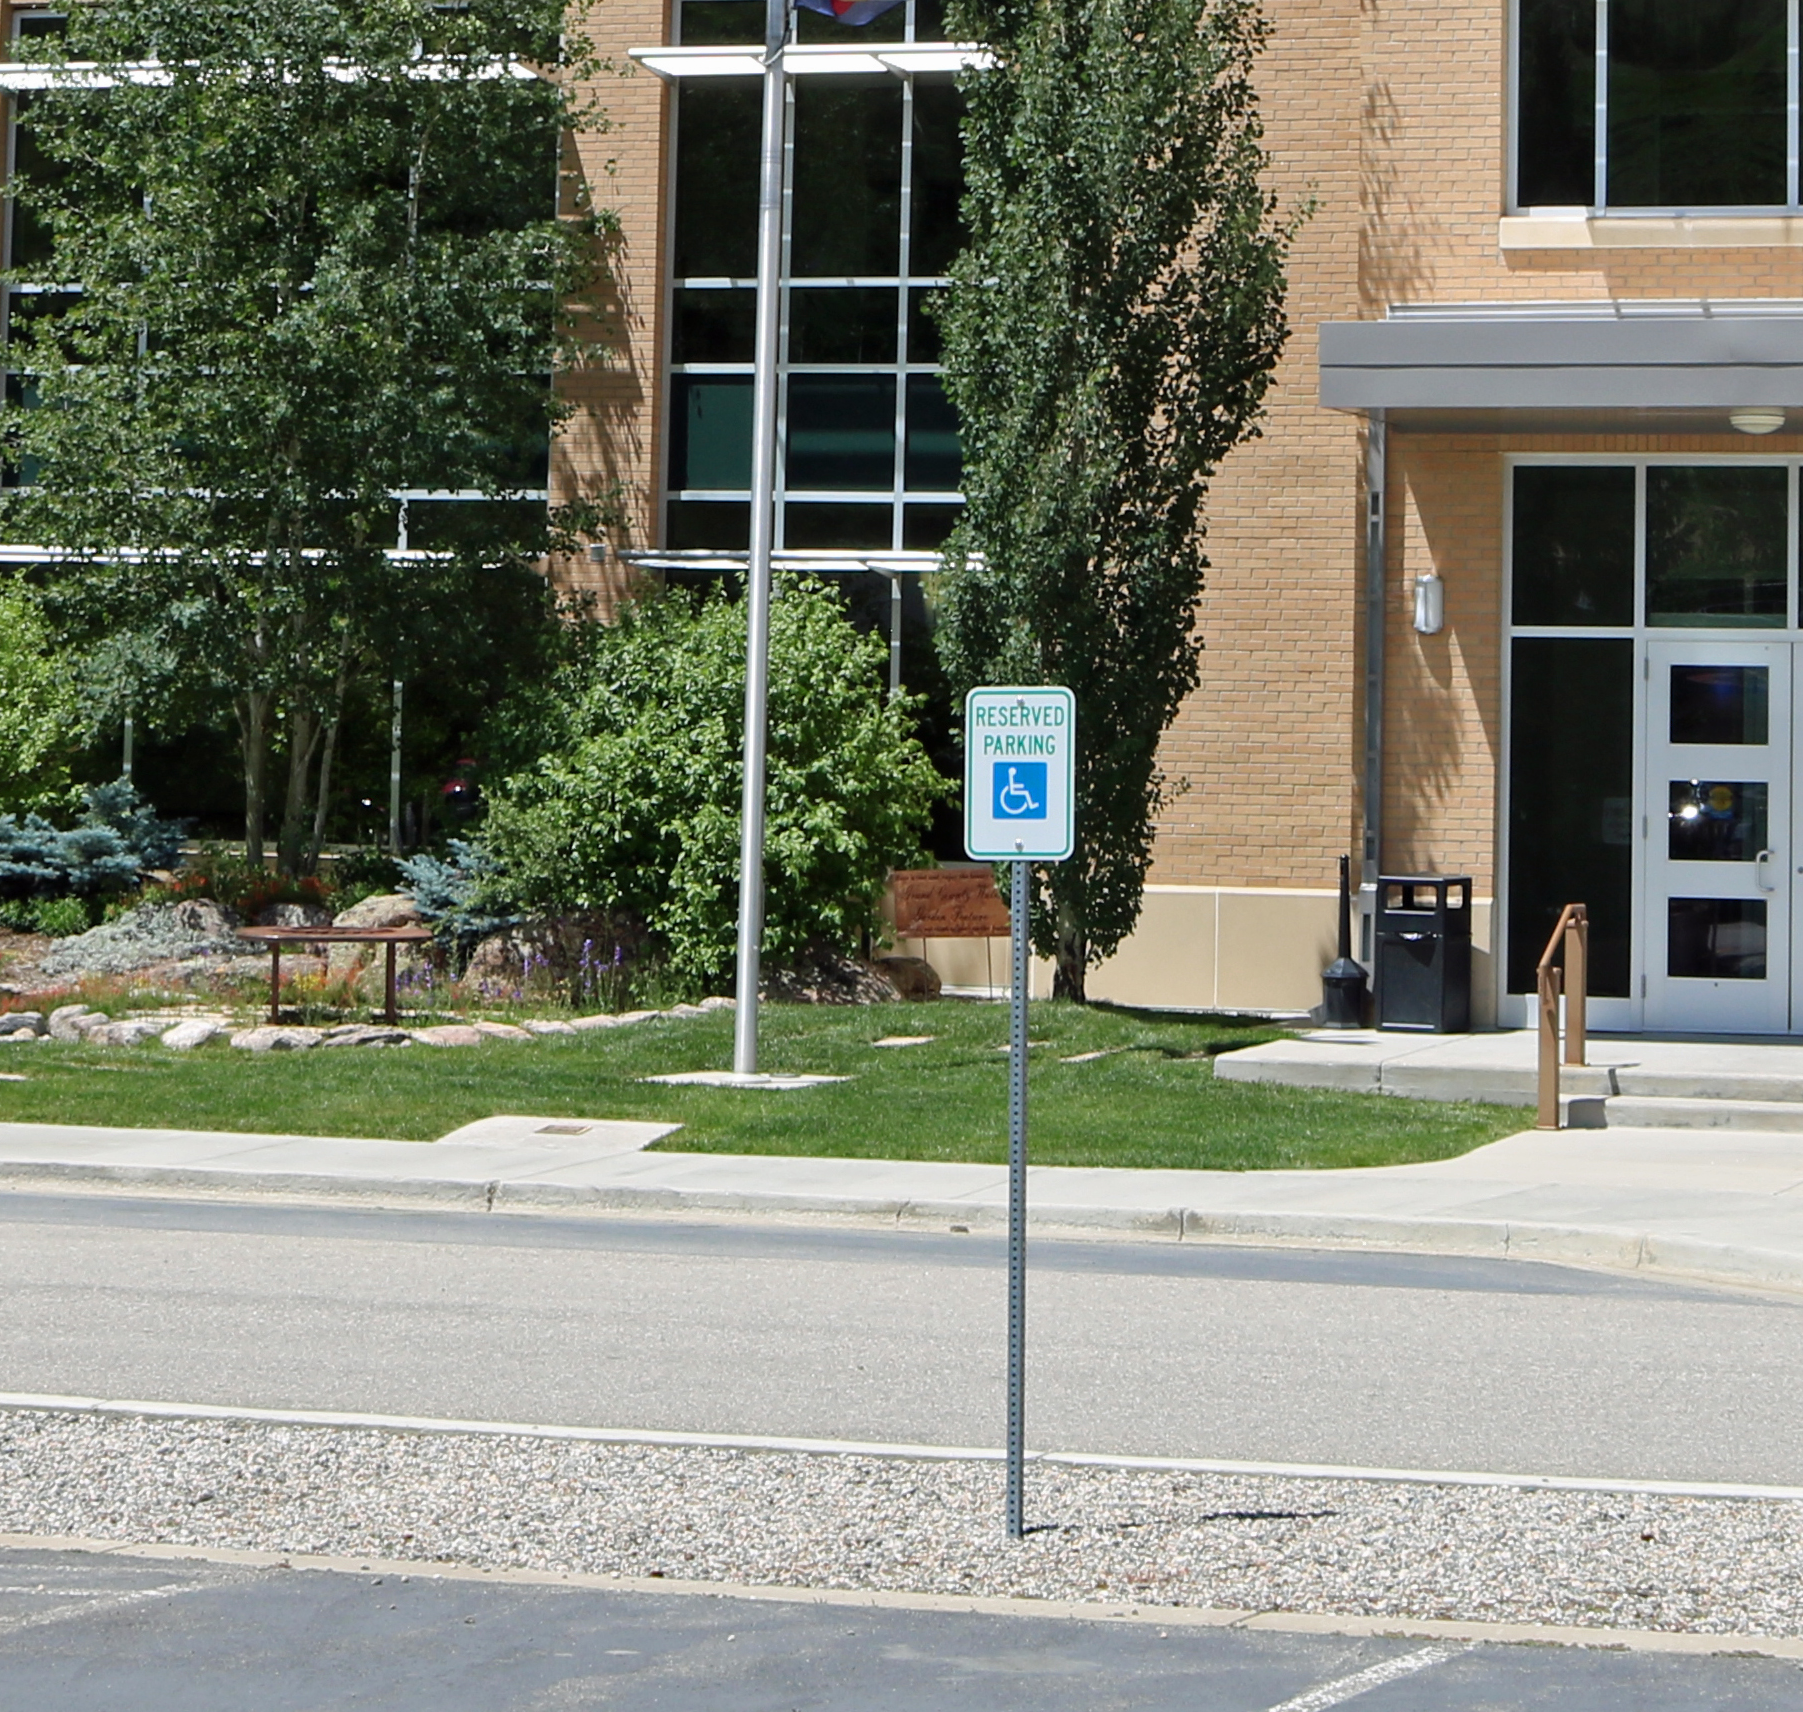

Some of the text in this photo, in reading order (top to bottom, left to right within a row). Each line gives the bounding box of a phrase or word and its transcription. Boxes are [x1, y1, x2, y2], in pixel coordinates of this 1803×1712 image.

[976, 706, 1065, 727] RESERVED
[983, 735, 1056, 756] PARKING
[902, 884, 934, 901] Grand
